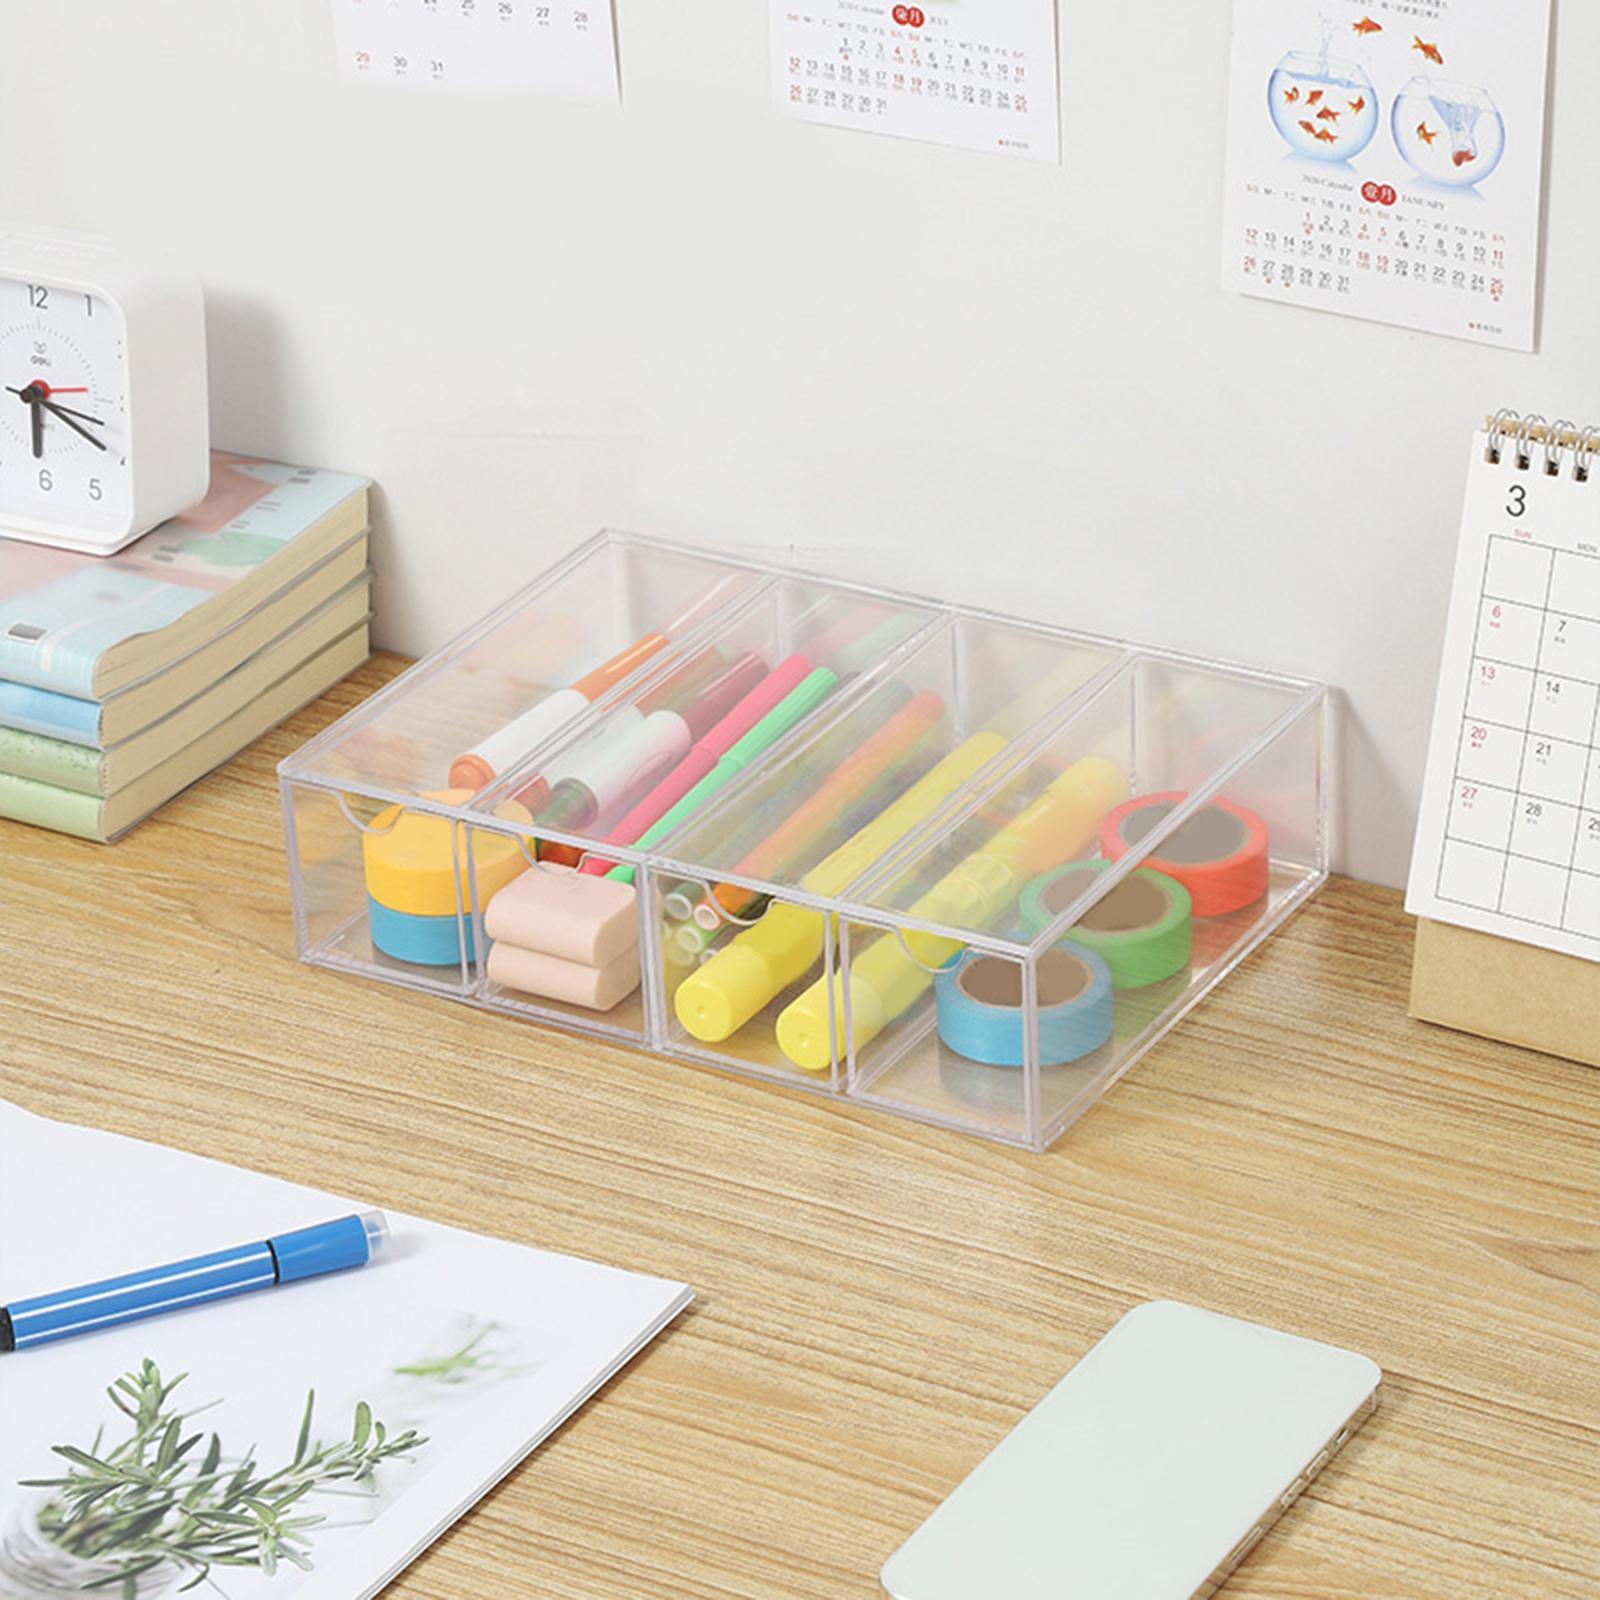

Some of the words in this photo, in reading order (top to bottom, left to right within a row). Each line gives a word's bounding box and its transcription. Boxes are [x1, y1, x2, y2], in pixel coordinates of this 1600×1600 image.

[498, 1, 512, 14] 26
[536, 6, 550, 17] 27
[574, 10, 588, 22] 28
[393, 55, 408, 68] 30
[431, 60, 444, 72] 31
[27, 284, 48, 309] 12
[85, 293, 92, 316] 1
[39, 469, 53, 491] 6
[89, 478, 102, 501] 5
[1506, 484, 1526, 517] 3
[1514, 528, 1532, 540] SUN
[1577, 542, 1599, 554] MON
[1491, 605, 1501, 618] 6
[1558, 620, 1567, 633] 7
[1480, 666, 1496, 680] 13
[1546, 681, 1561, 694] 14
[1470, 726, 1488, 741] 20
[1535, 742, 1551, 756] 21
[1461, 786, 1478, 800] 27
[1525, 802, 1543, 817] 28
